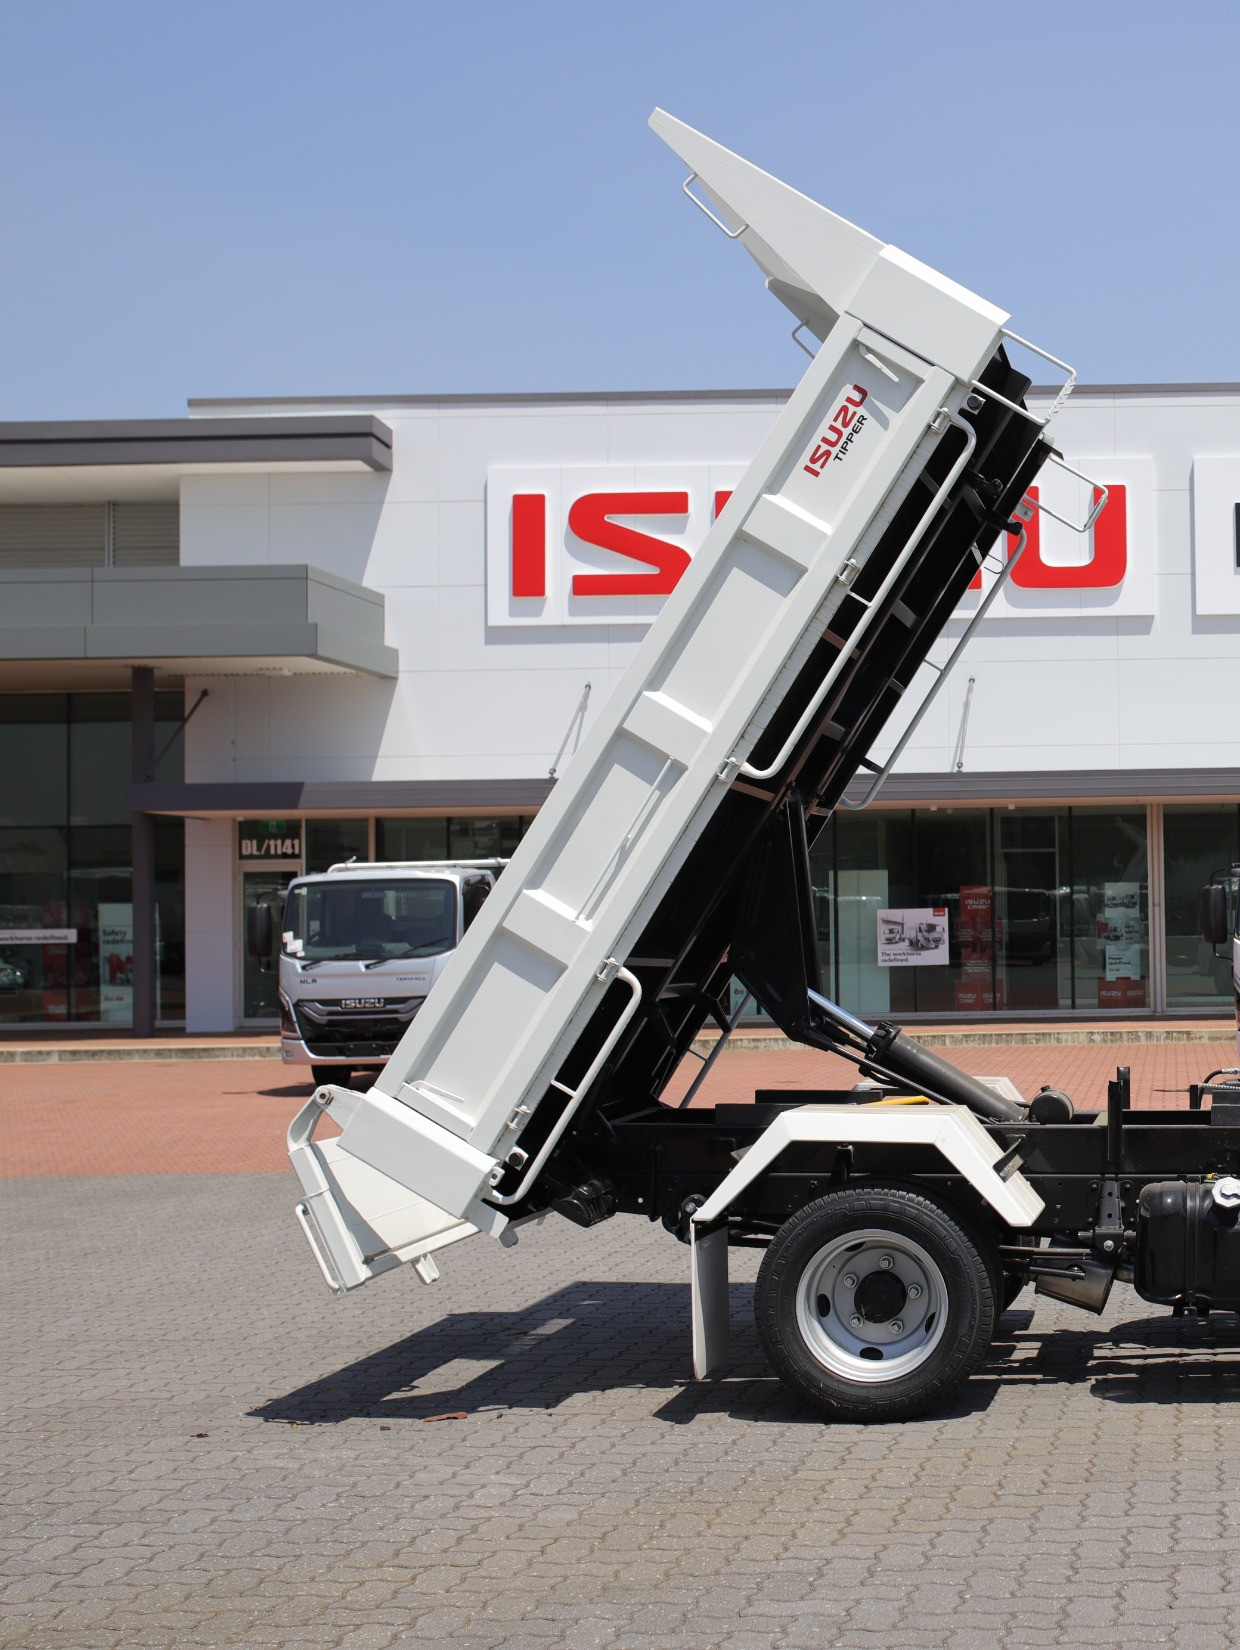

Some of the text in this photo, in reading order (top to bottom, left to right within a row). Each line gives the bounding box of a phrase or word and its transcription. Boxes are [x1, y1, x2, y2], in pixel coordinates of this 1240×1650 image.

[803, 384, 868, 477] ISUZU
[833, 414, 868, 461] TIPPER
[512, 485, 1128, 597] ISU
[241, 839, 300, 855] DL/1141
[341, 998, 385, 1009] ISUZU
